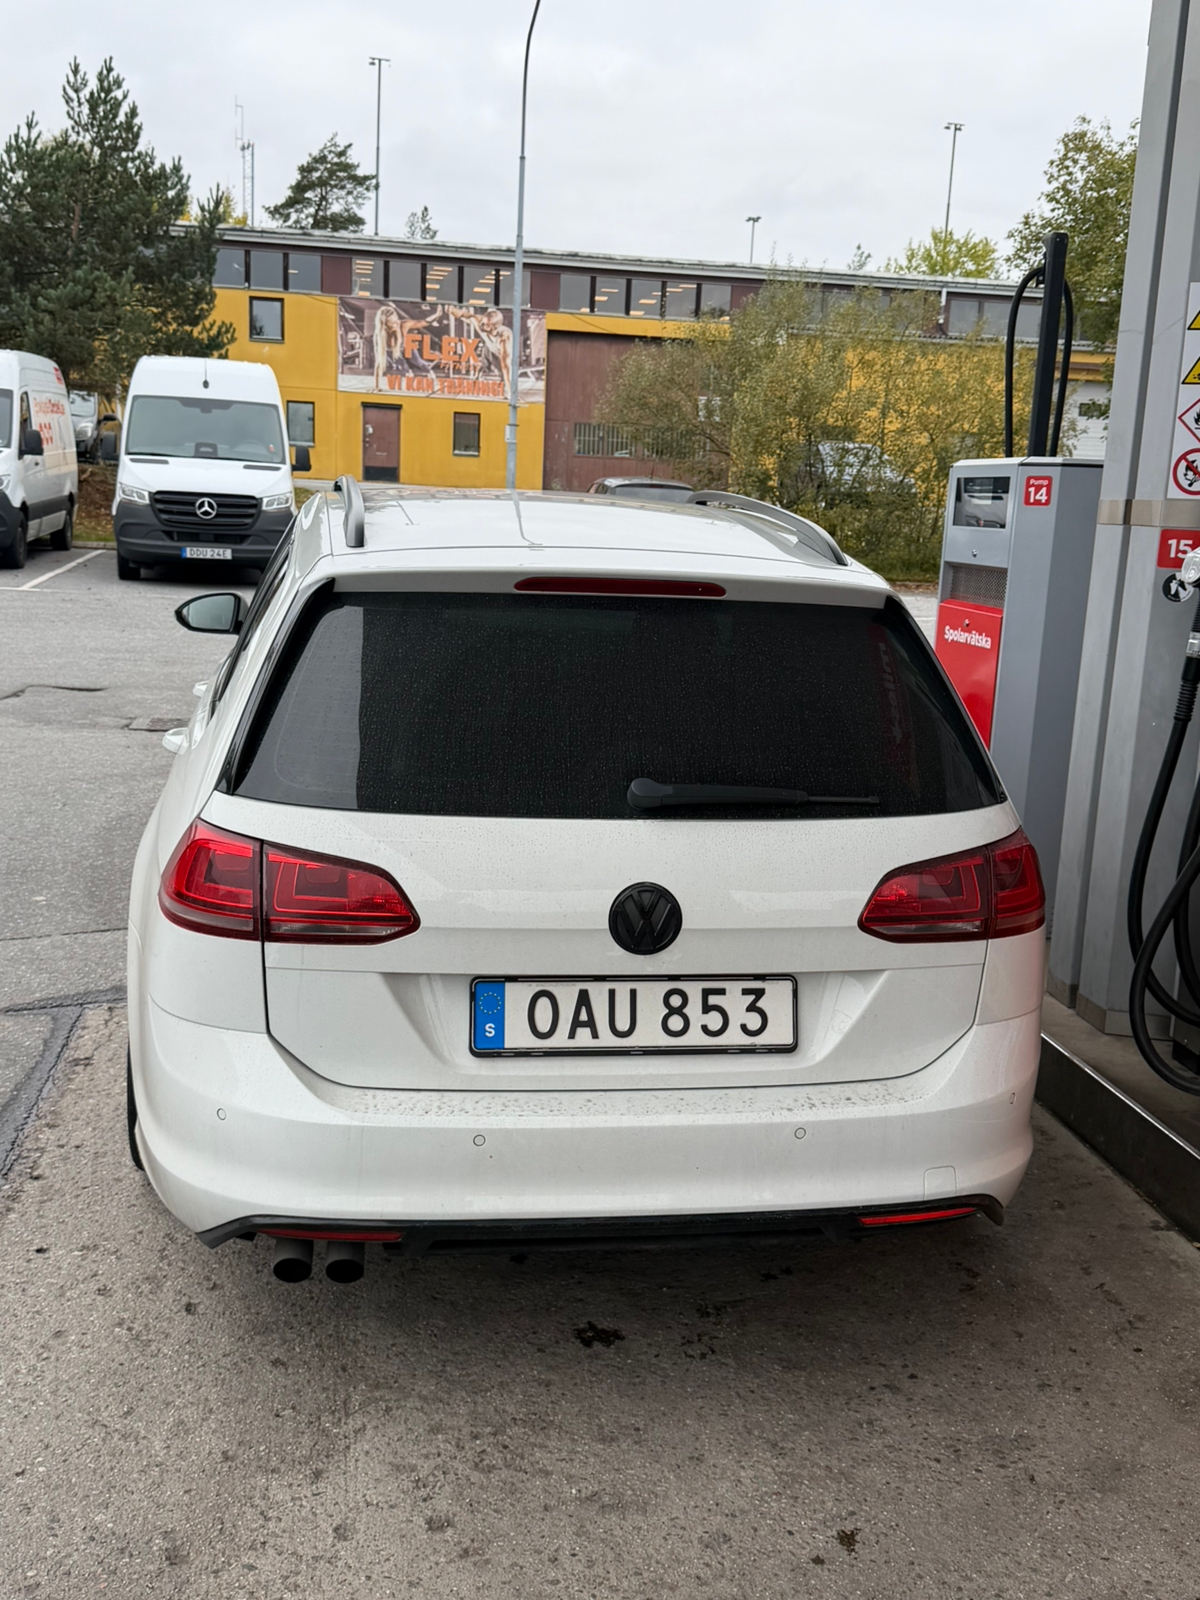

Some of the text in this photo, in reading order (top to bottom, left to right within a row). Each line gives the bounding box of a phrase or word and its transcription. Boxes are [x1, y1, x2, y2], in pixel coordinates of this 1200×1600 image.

[404, 333, 481, 363] FLEX
[386, 374, 401, 391] VI
[405, 376, 434, 393] KAN
[1029, 478, 1049, 486] Pump
[1028, 486, 1048, 504] 14
[189, 548, 228, 559] DDU 24E
[1167, 538, 1193, 559] 15
[944, 625, 992, 650] Spolarvätska
[661, 987, 768, 1038] 853
[484, 1022, 496, 1037] S
